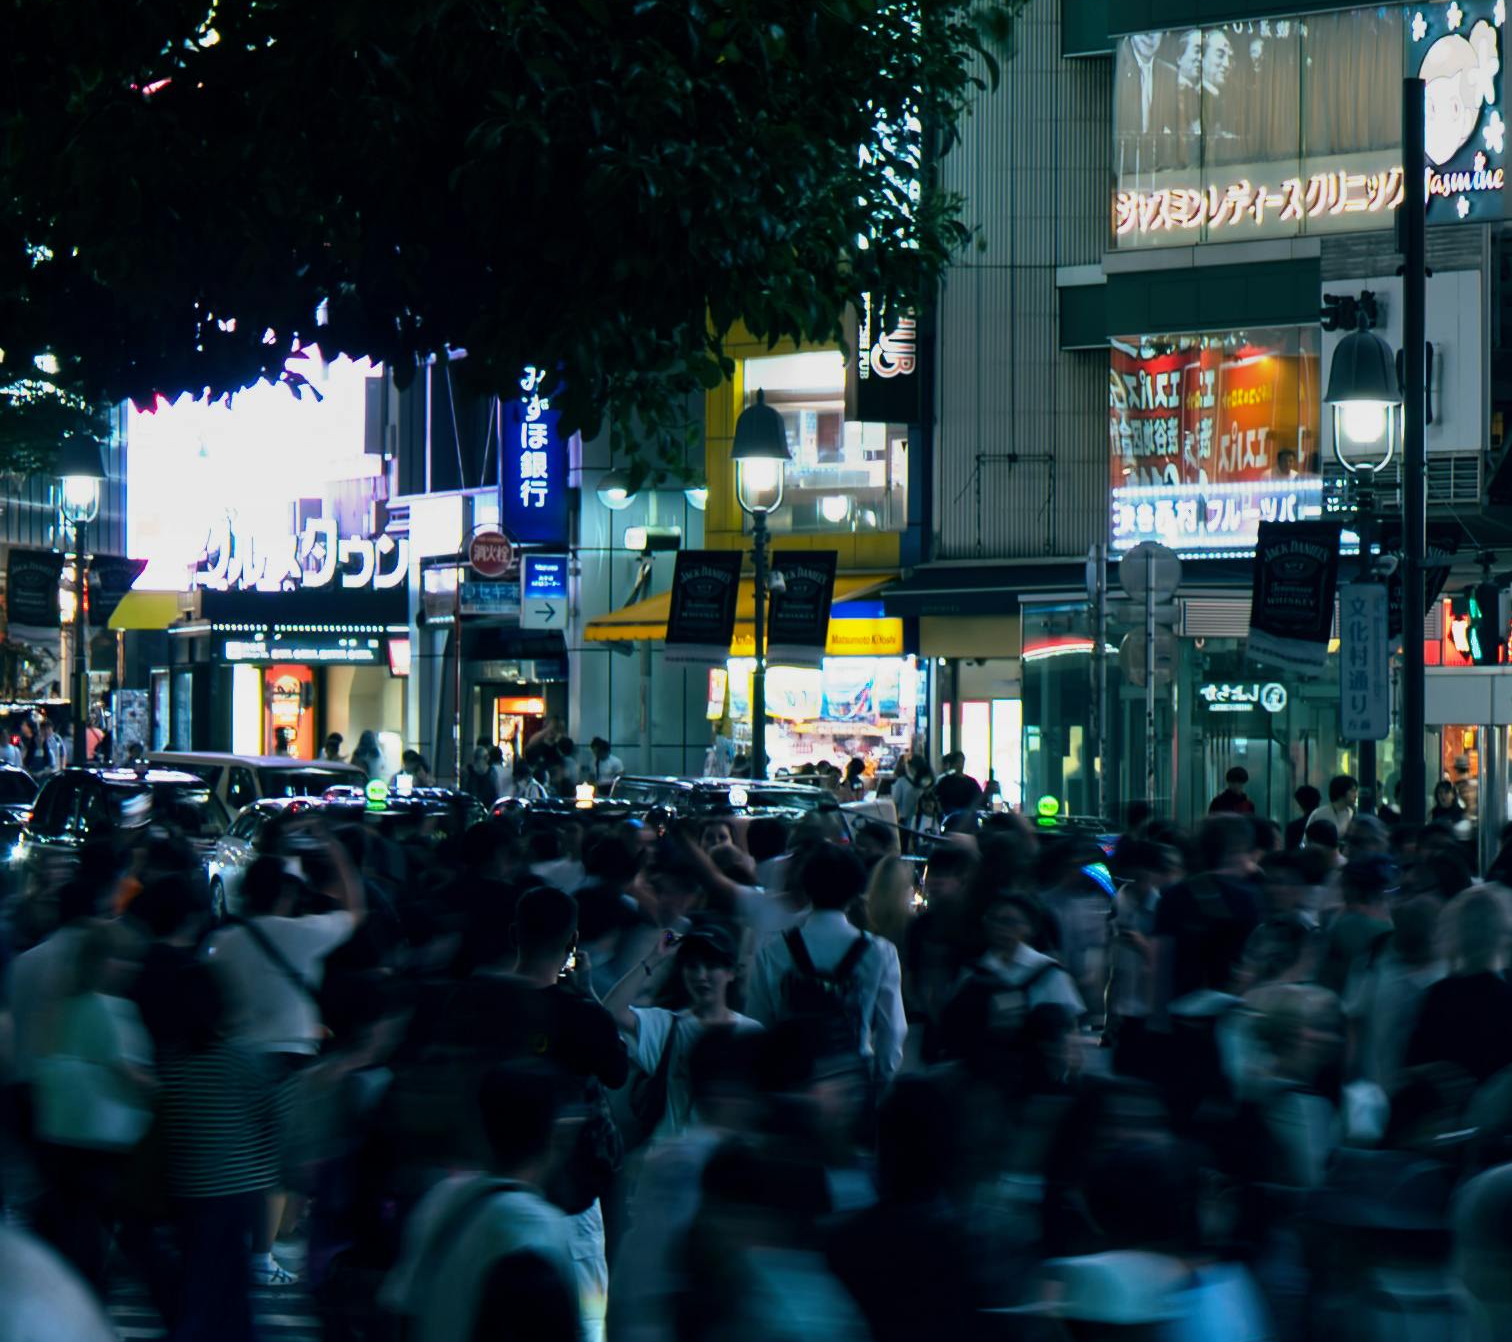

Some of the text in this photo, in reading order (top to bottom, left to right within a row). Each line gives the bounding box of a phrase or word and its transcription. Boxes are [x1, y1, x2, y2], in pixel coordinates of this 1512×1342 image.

[519, 366, 549, 508] みずほ銀行
[473, 544, 510, 563] 消火栓
[1264, 544, 1289, 563] JACK
[831, 634, 870, 646] Matsumoto
[1349, 595, 1369, 714] 文化村通り
